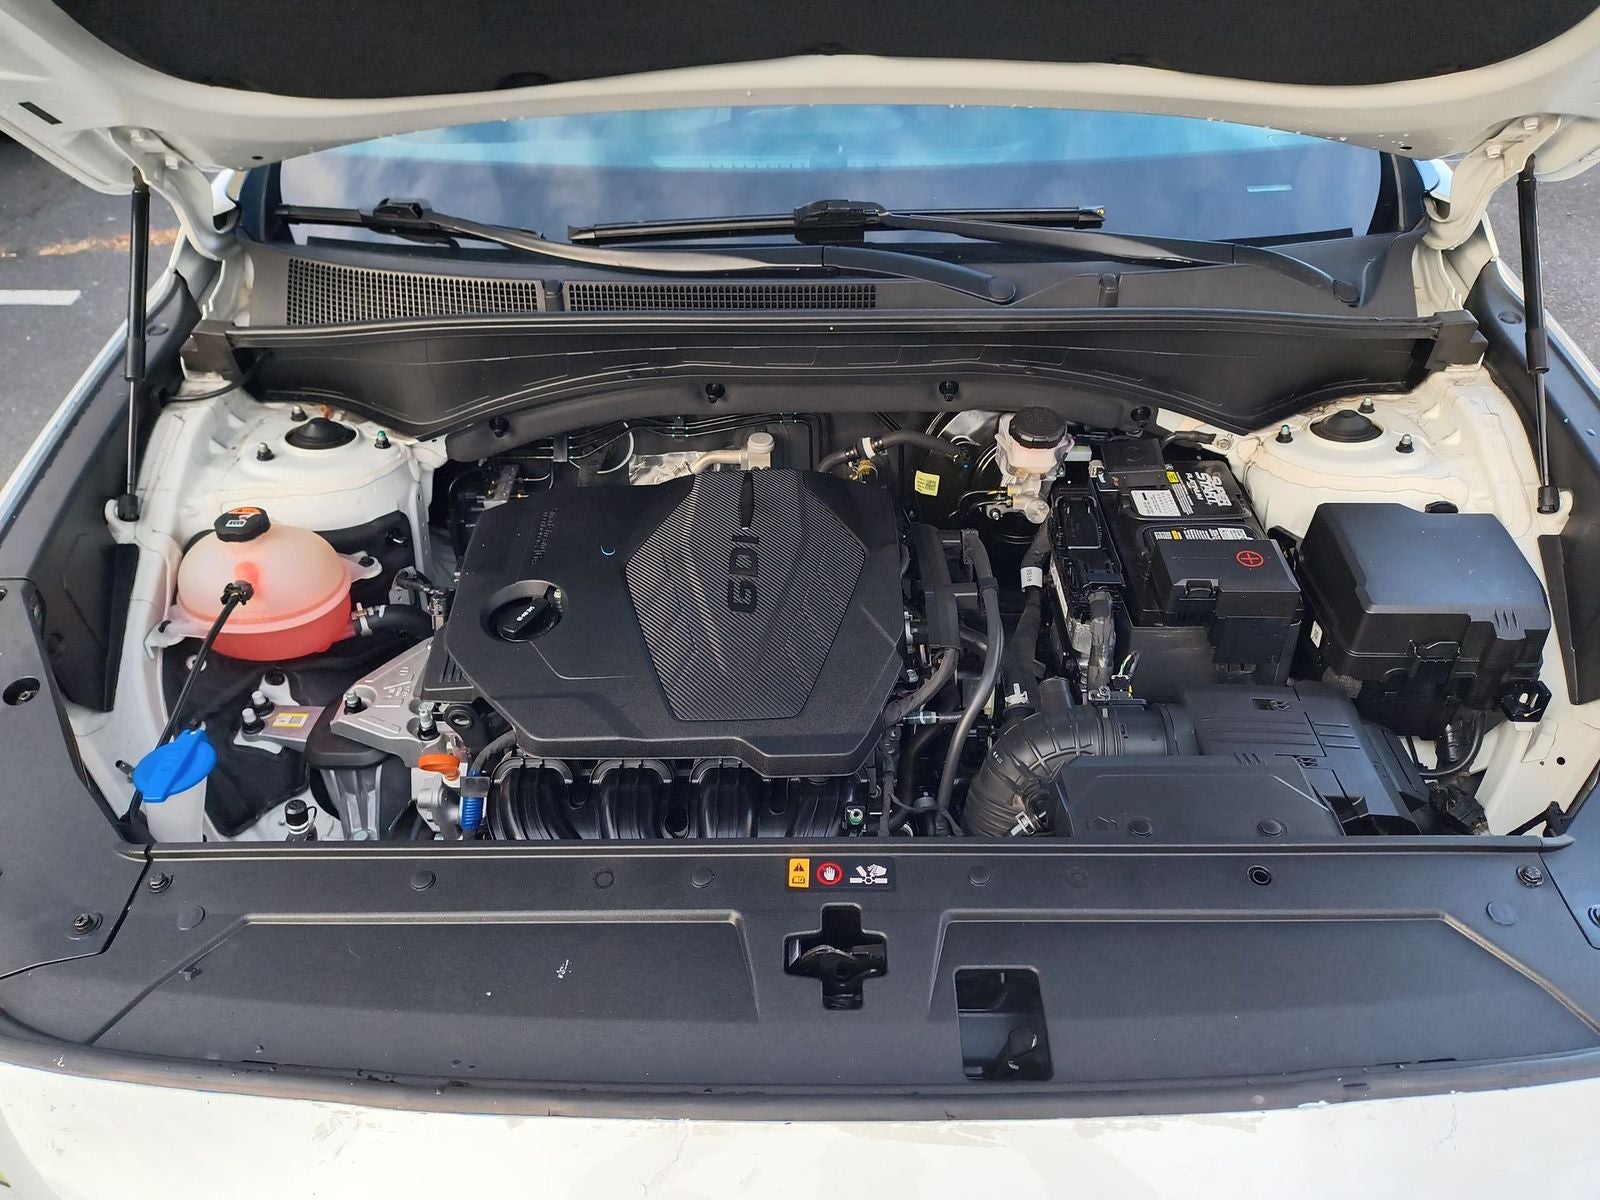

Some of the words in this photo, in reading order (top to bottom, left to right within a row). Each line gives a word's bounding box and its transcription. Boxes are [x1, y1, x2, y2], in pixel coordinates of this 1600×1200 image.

[1185, 472, 1205, 501] PLATINUM
[1195, 471, 1218, 505] START
[1210, 475, 1233, 507] SUPER
[727, 534, 760, 616] GDI
